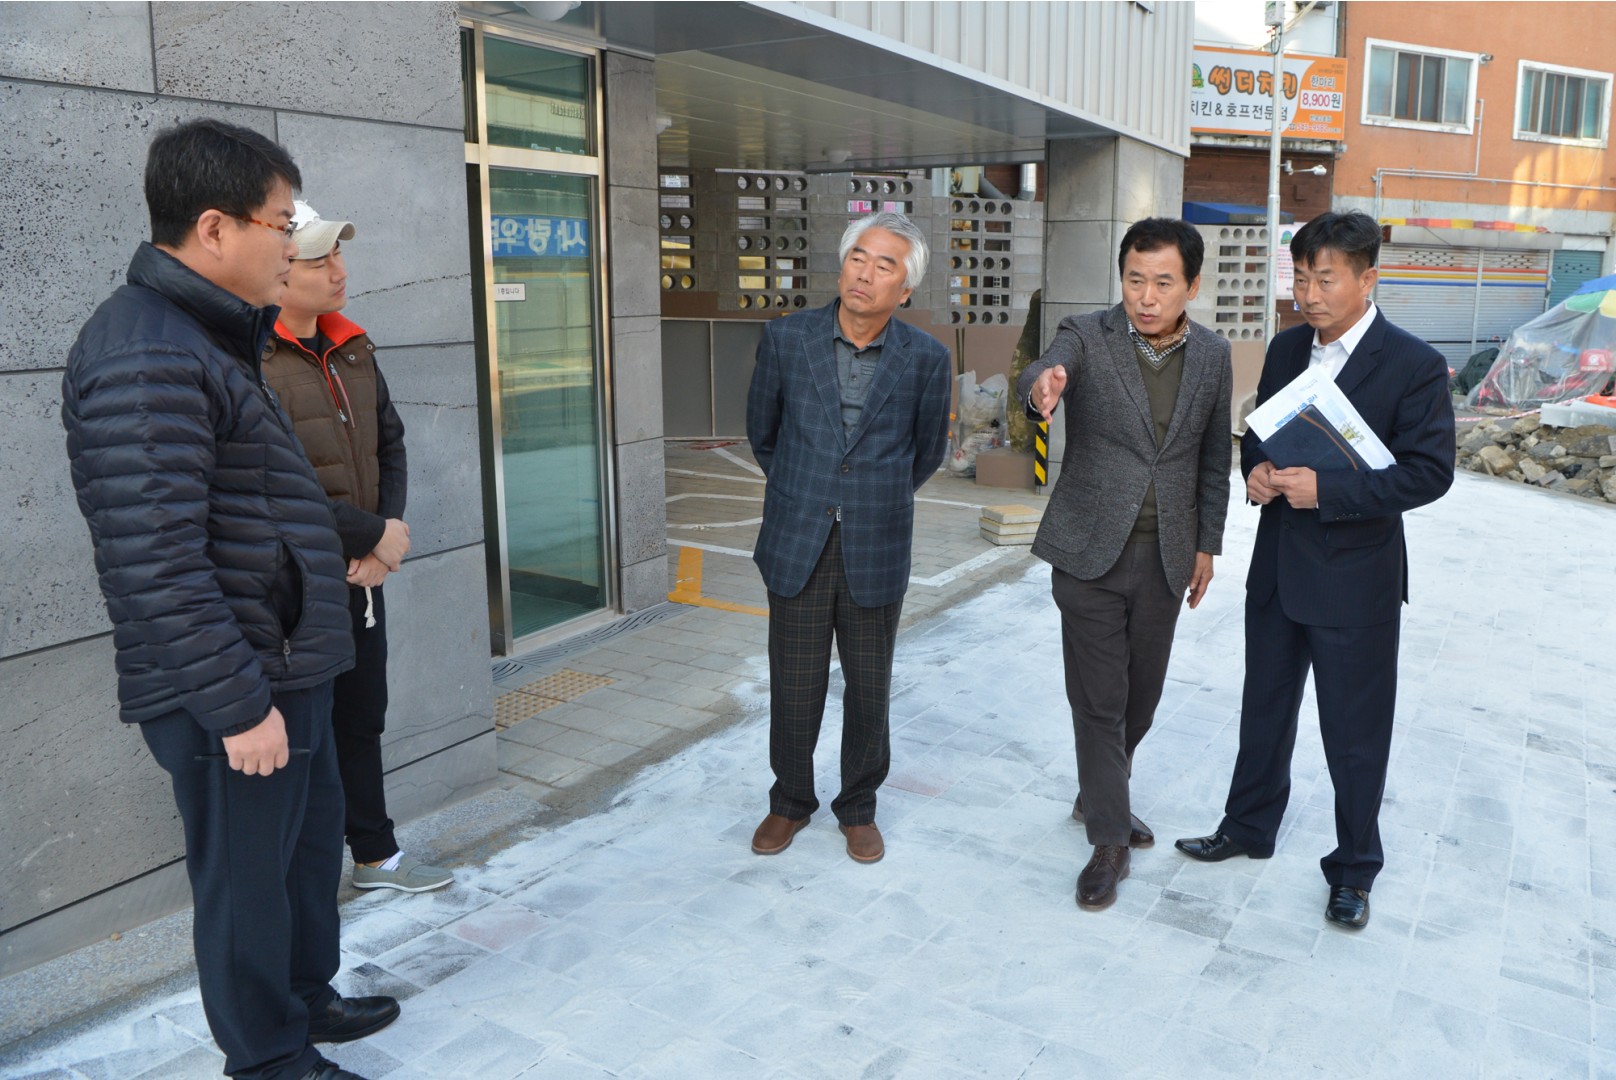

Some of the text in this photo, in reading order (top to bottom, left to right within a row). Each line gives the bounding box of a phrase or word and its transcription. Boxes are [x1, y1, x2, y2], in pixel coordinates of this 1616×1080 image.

[1208, 65, 1298, 100] 썬더치킨
[1311, 76, 1336, 89] 한마리
[1302, 92, 1342, 109] 8,900원
